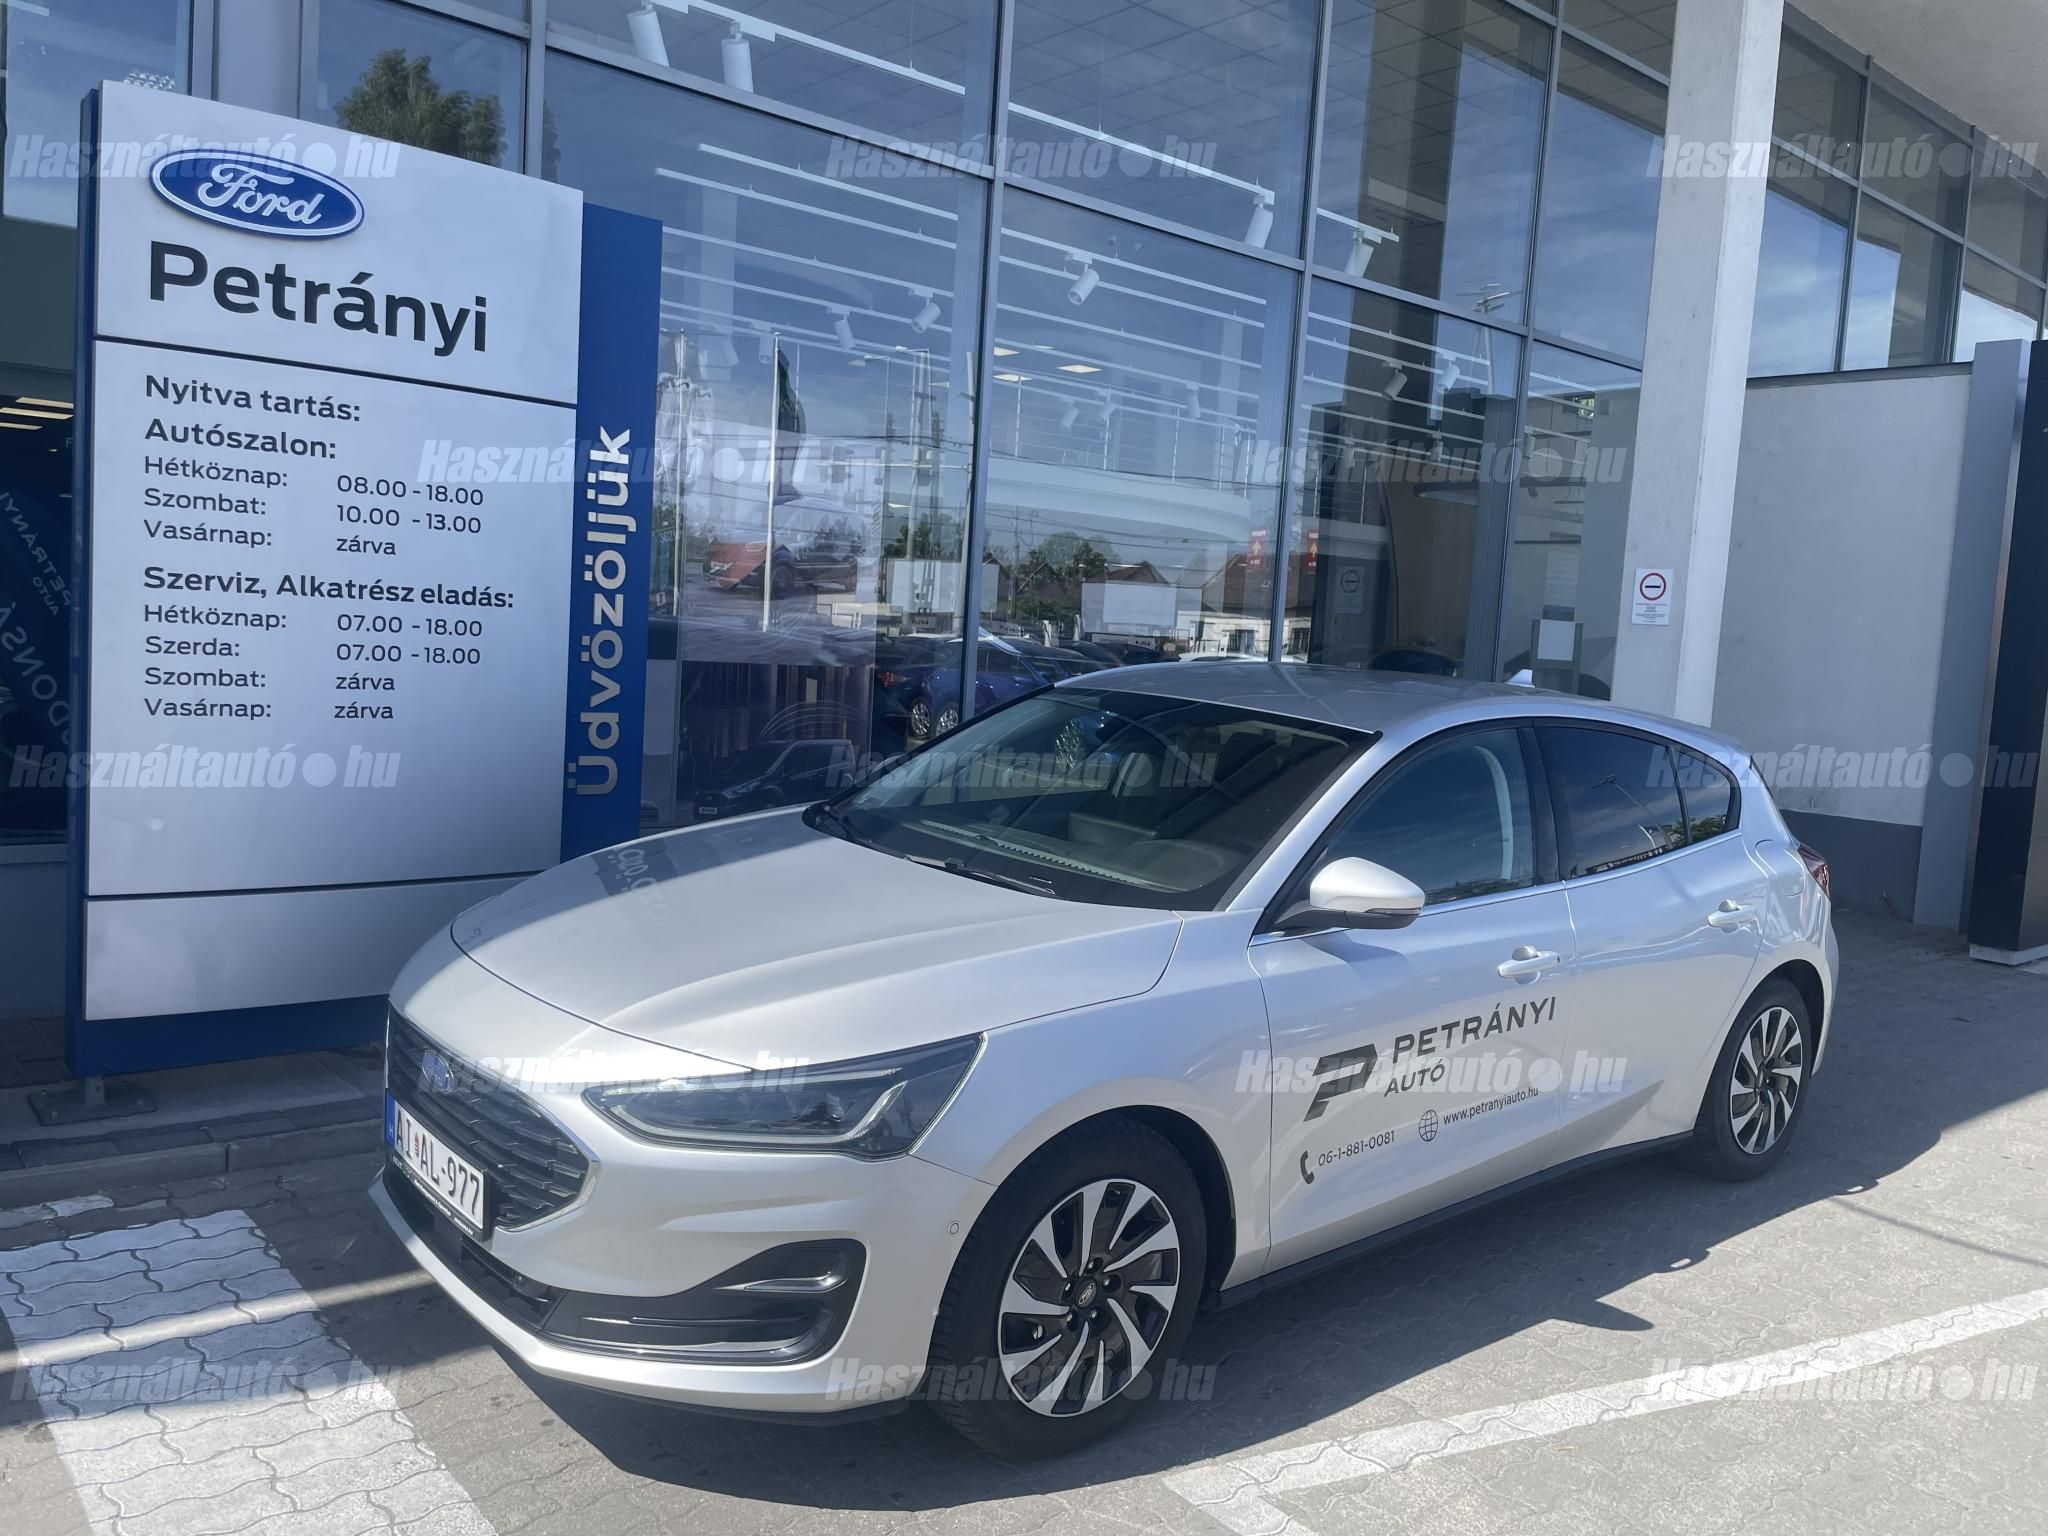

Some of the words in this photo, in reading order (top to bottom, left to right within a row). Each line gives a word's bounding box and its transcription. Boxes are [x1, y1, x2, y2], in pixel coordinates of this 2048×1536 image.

[197, 161, 322, 226] Ford
[149, 240, 487, 357] Petrányi
[146, 374, 253, 410] Nyitva
[259, 389, 360, 422] tartás:
[144, 417, 336, 460] Autószalon:
[144, 455, 288, 489] Hétköznap:
[337, 474, 407, 498] 08.00
[426, 483, 484, 506] 18.00
[143, 487, 266, 516] Szombat:
[336, 504, 400, 527] 10.00
[425, 512, 482, 534] 13.00
[143, 519, 272, 549] Vasárnap:
[336, 534, 397, 556] zárva
[143, 566, 268, 599] Szerviz,
[275, 574, 415, 603] Alkatrész
[420, 583, 514, 609] eladás:
[144, 604, 287, 632] Hétköznap:
[337, 613, 403, 634] 07.00
[425, 617, 483, 637] 18.00
[567, 425, 637, 795] Üdvözöljük
[144, 635, 240, 657] Szerda:
[336, 643, 402, 663] 07.00
[423, 646, 481, 665] 18.00
[144, 666, 266, 688] Szombat:
[335, 672, 396, 691] zárva
[143, 697, 272, 721] Vasárnap:
[333, 700, 394, 720] zárva
[1392, 997, 1556, 1064] PETRÁNYI
[1383, 1058, 1446, 1098] AUTÓ
[1443, 1086, 1539, 1126] www.petranyiauto.hu
[1318, 1130, 1396, 1168] 06-1-881-0081
